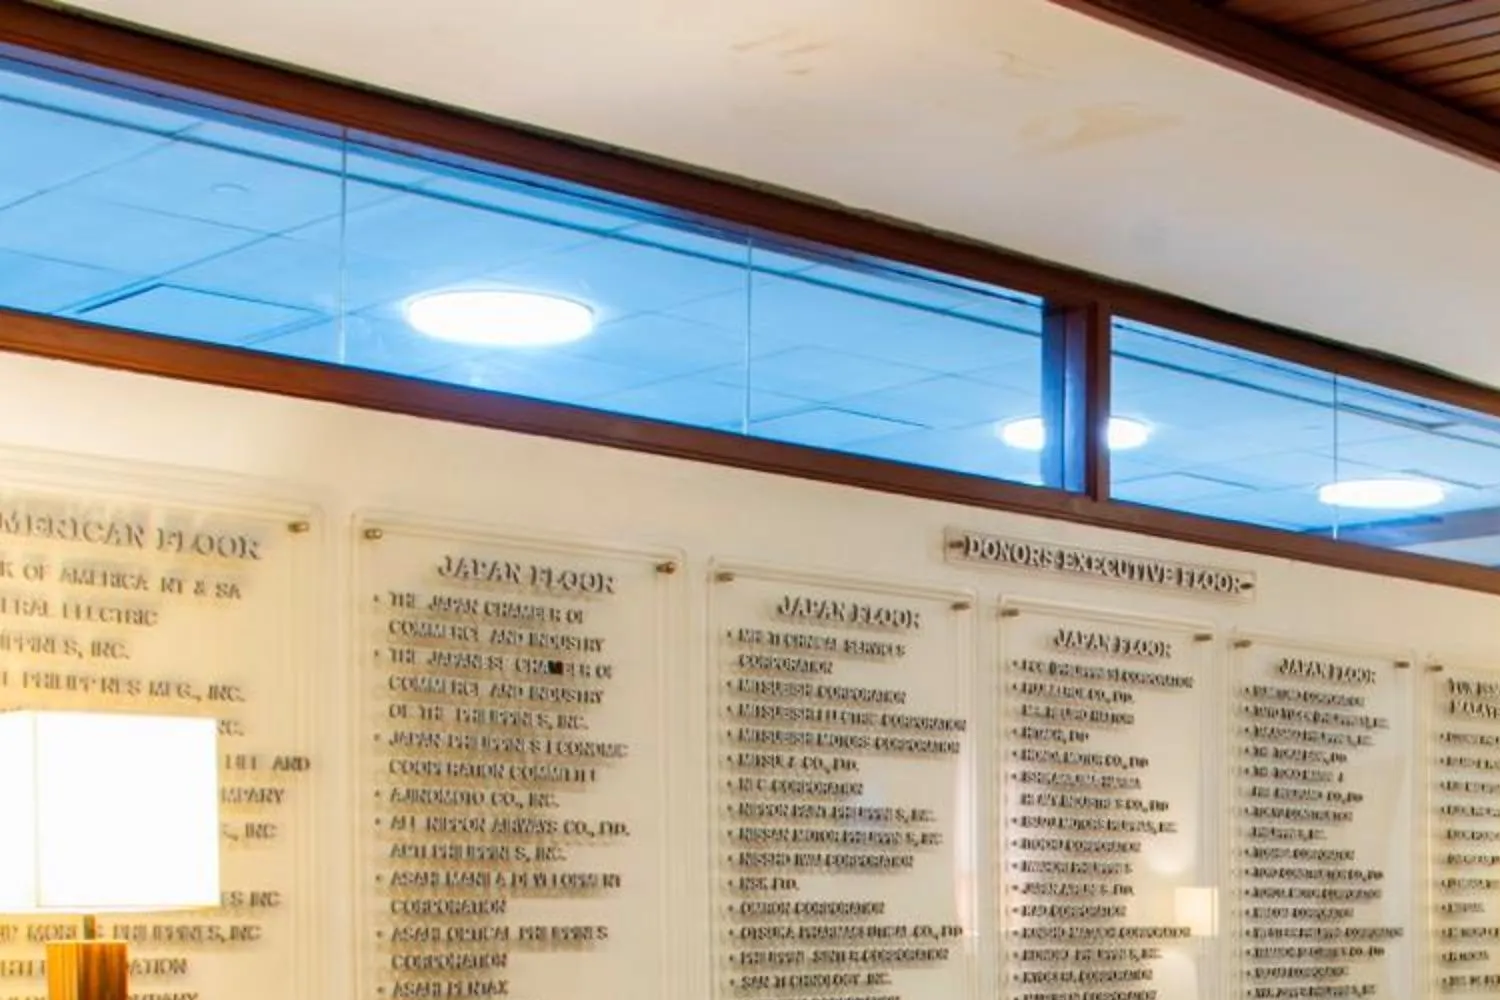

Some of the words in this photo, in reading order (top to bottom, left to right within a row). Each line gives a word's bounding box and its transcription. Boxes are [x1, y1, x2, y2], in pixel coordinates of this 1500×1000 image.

[0, 512, 145, 548] MERICAN
[155, 526, 262, 560] FLOOR
[436, 555, 521, 584] JAPAN
[530, 564, 617, 594] FLOOR
[1178, 566, 1241, 592] FLOOR
[0, 597, 52, 618] ERAL
